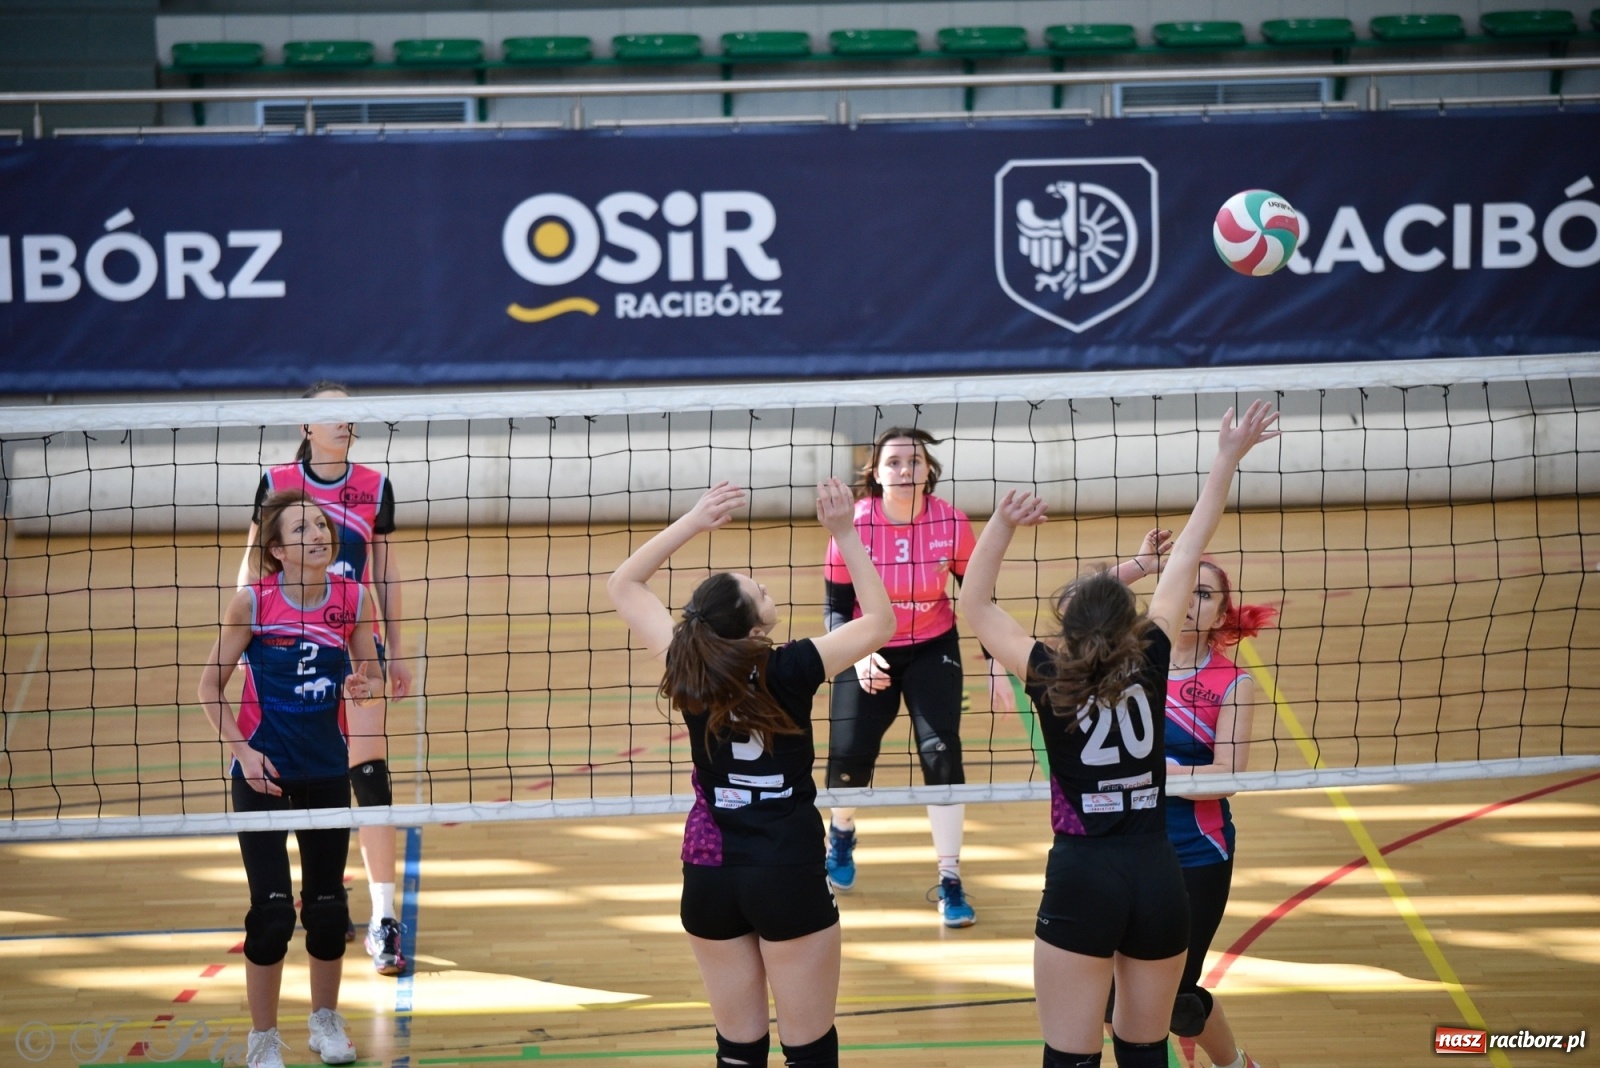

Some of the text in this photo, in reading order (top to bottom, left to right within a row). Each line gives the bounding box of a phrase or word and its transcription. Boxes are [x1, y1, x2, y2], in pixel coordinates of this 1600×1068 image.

[615, 286, 783, 320] RACIBÓRZ
[895, 538, 909, 563] 3
[297, 642, 319, 676] 2
[1076, 684, 1154, 766] 20
